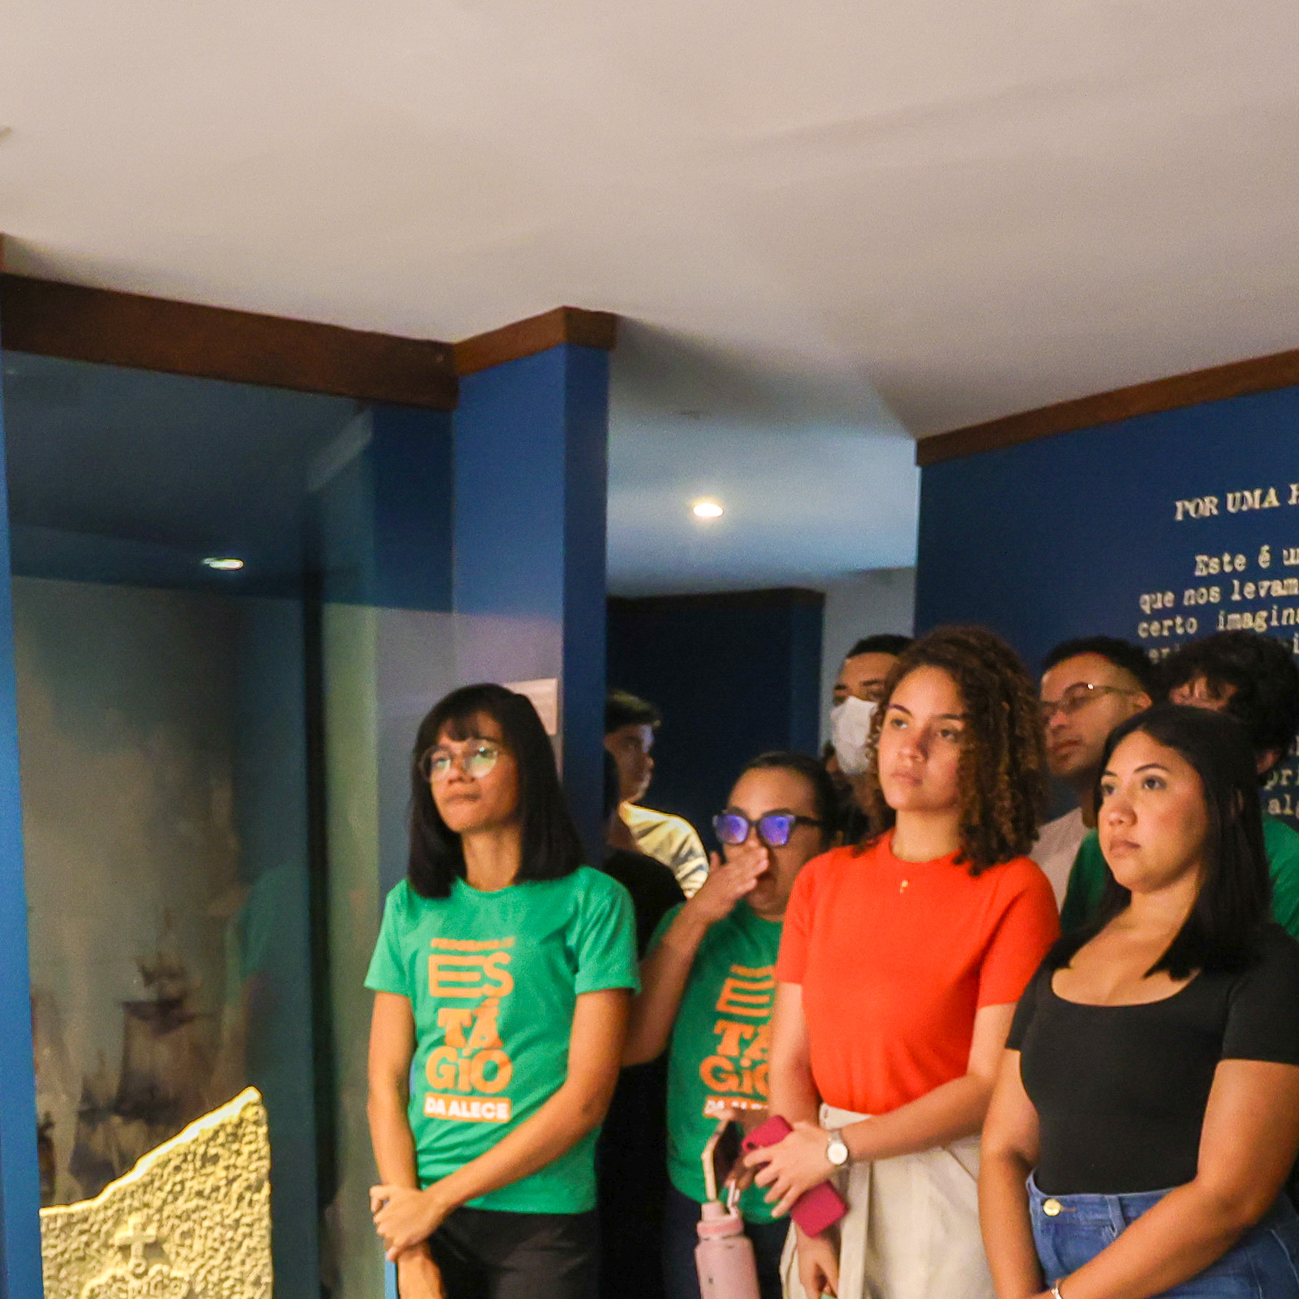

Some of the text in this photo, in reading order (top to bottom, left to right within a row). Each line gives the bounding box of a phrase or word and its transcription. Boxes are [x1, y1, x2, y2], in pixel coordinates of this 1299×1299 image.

[1175, 495, 1218, 521] POR
[1226, 488, 1280, 514] UMA
[1194, 552, 1247, 577] Este
[1258, 545, 1271, 568] é
[1139, 589, 1175, 614] que
[1183, 583, 1221, 606] nos
[1231, 576, 1299, 602] levam
[1137, 614, 1198, 639] certo
[428, 951, 514, 998] ES
[425, 1096, 510, 1120] DA ALECE
